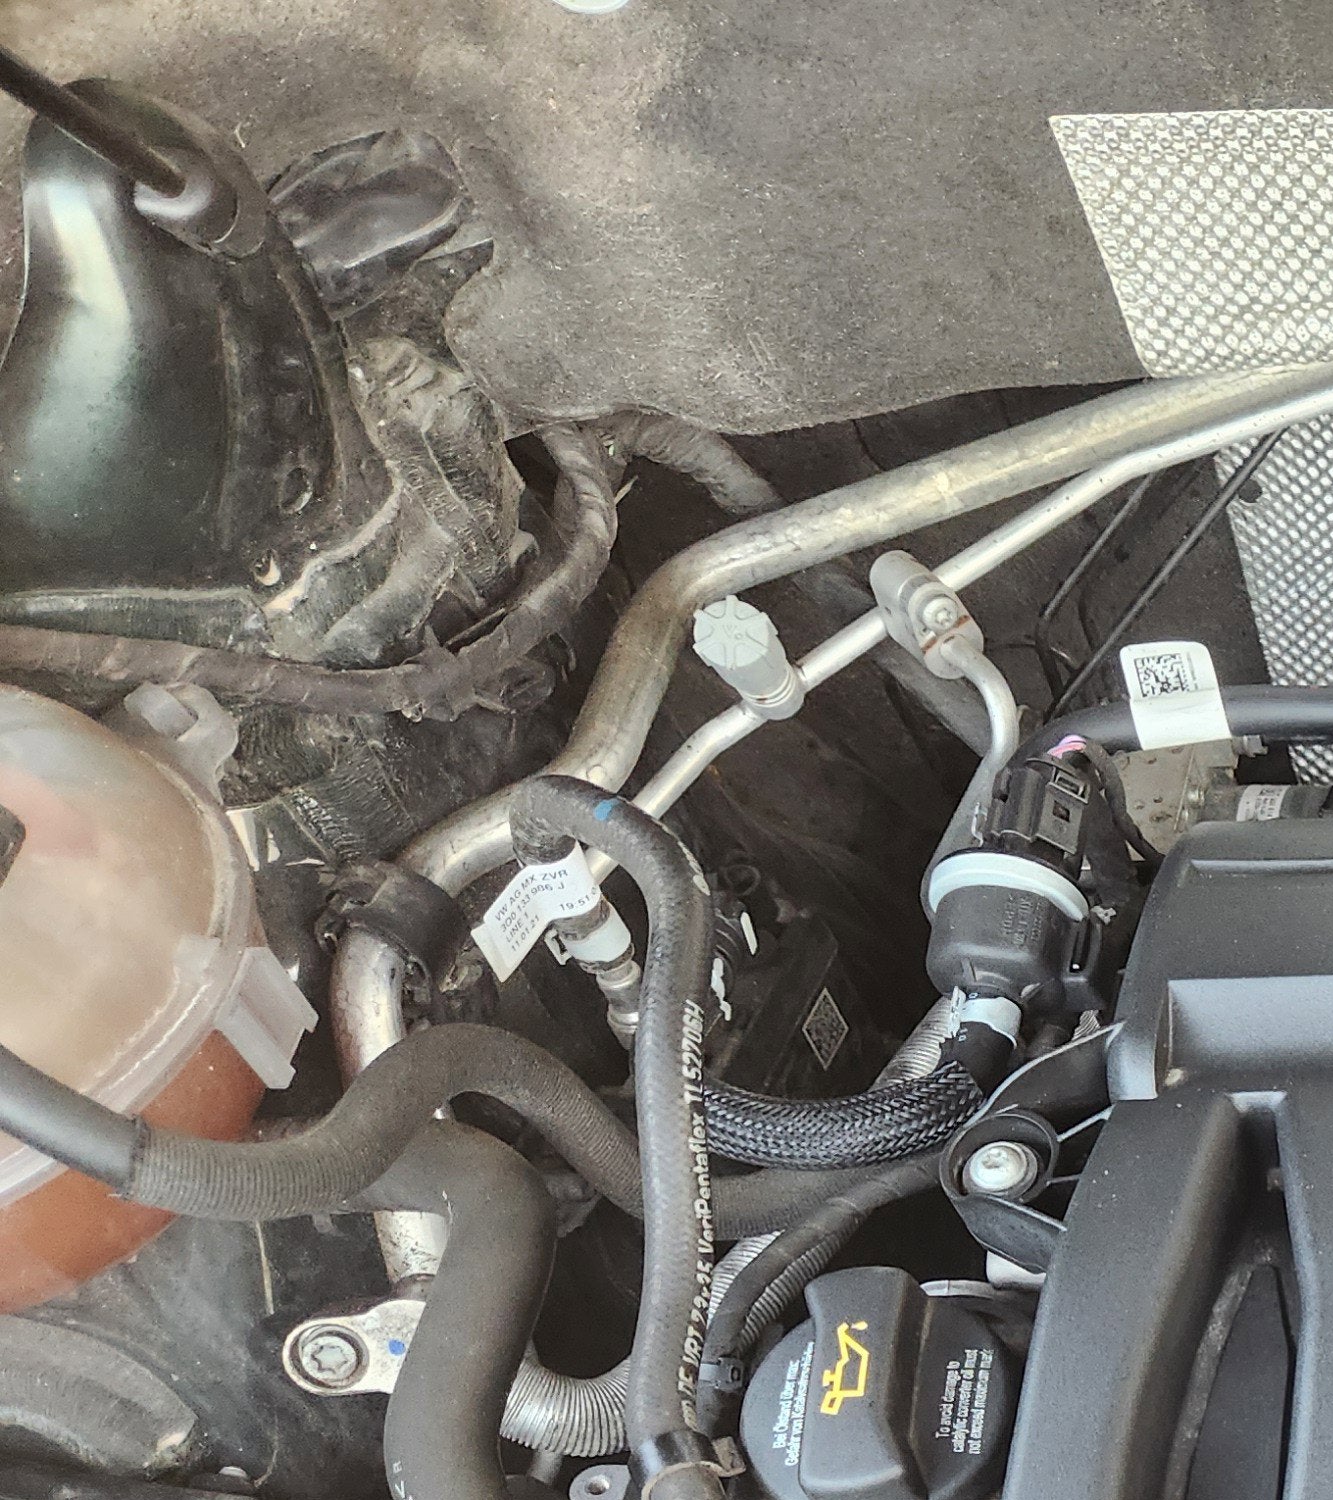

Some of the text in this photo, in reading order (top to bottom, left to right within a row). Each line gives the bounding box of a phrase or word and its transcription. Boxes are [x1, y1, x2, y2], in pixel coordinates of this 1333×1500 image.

[494, 869, 569, 922] VW AG MX ZVR
[505, 920, 524, 943] LINE
[935, 1360, 962, 1438] To avoid damage to
[772, 1432, 788, 1449] Bei
[967, 1439, 982, 1455] not
